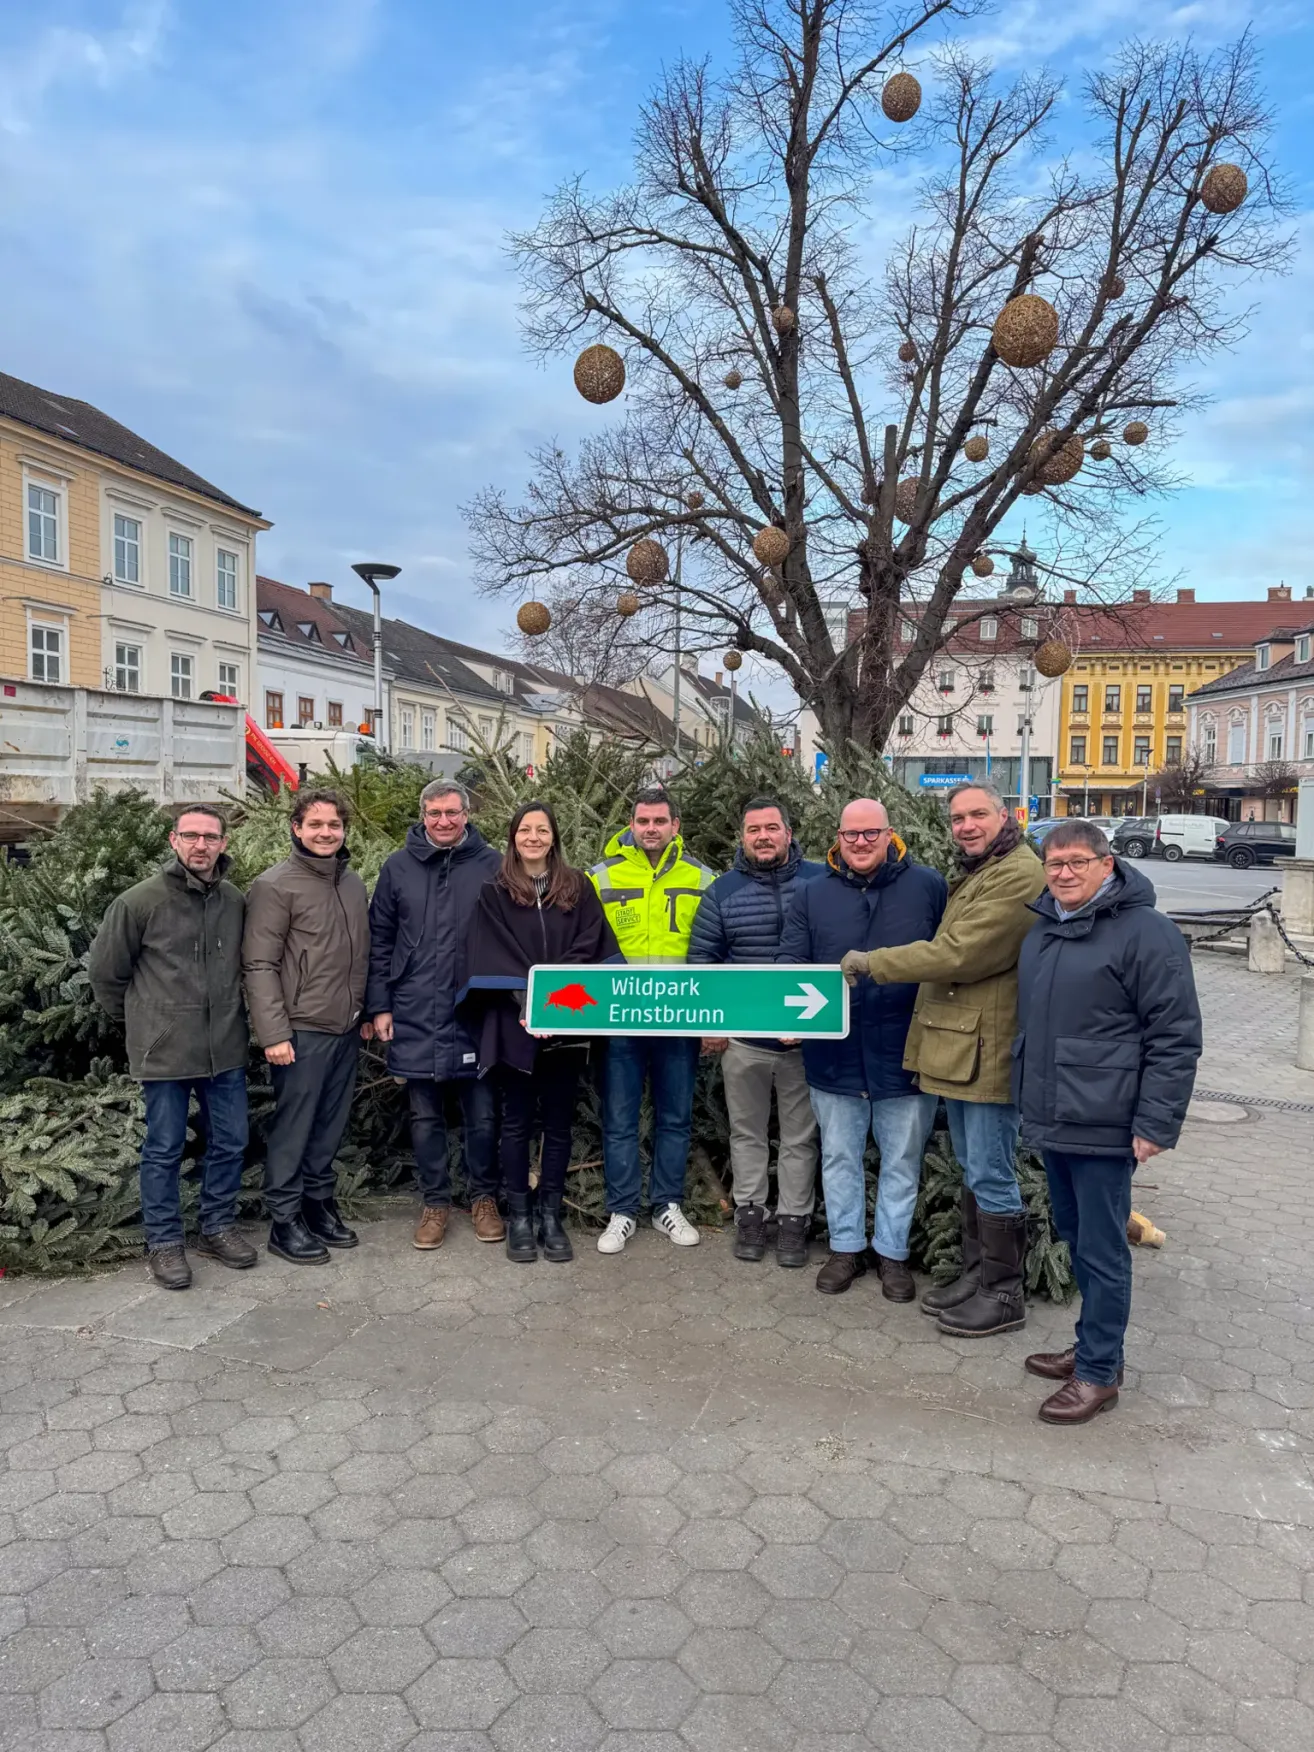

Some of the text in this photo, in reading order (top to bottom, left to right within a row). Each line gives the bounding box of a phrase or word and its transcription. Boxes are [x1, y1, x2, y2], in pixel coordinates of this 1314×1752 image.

[617, 908, 633, 916] STADT
[617, 914, 640, 925] SERVICE
[611, 976, 700, 1000] Wildpark
[609, 1003, 723, 1023] Ernstbrunn
